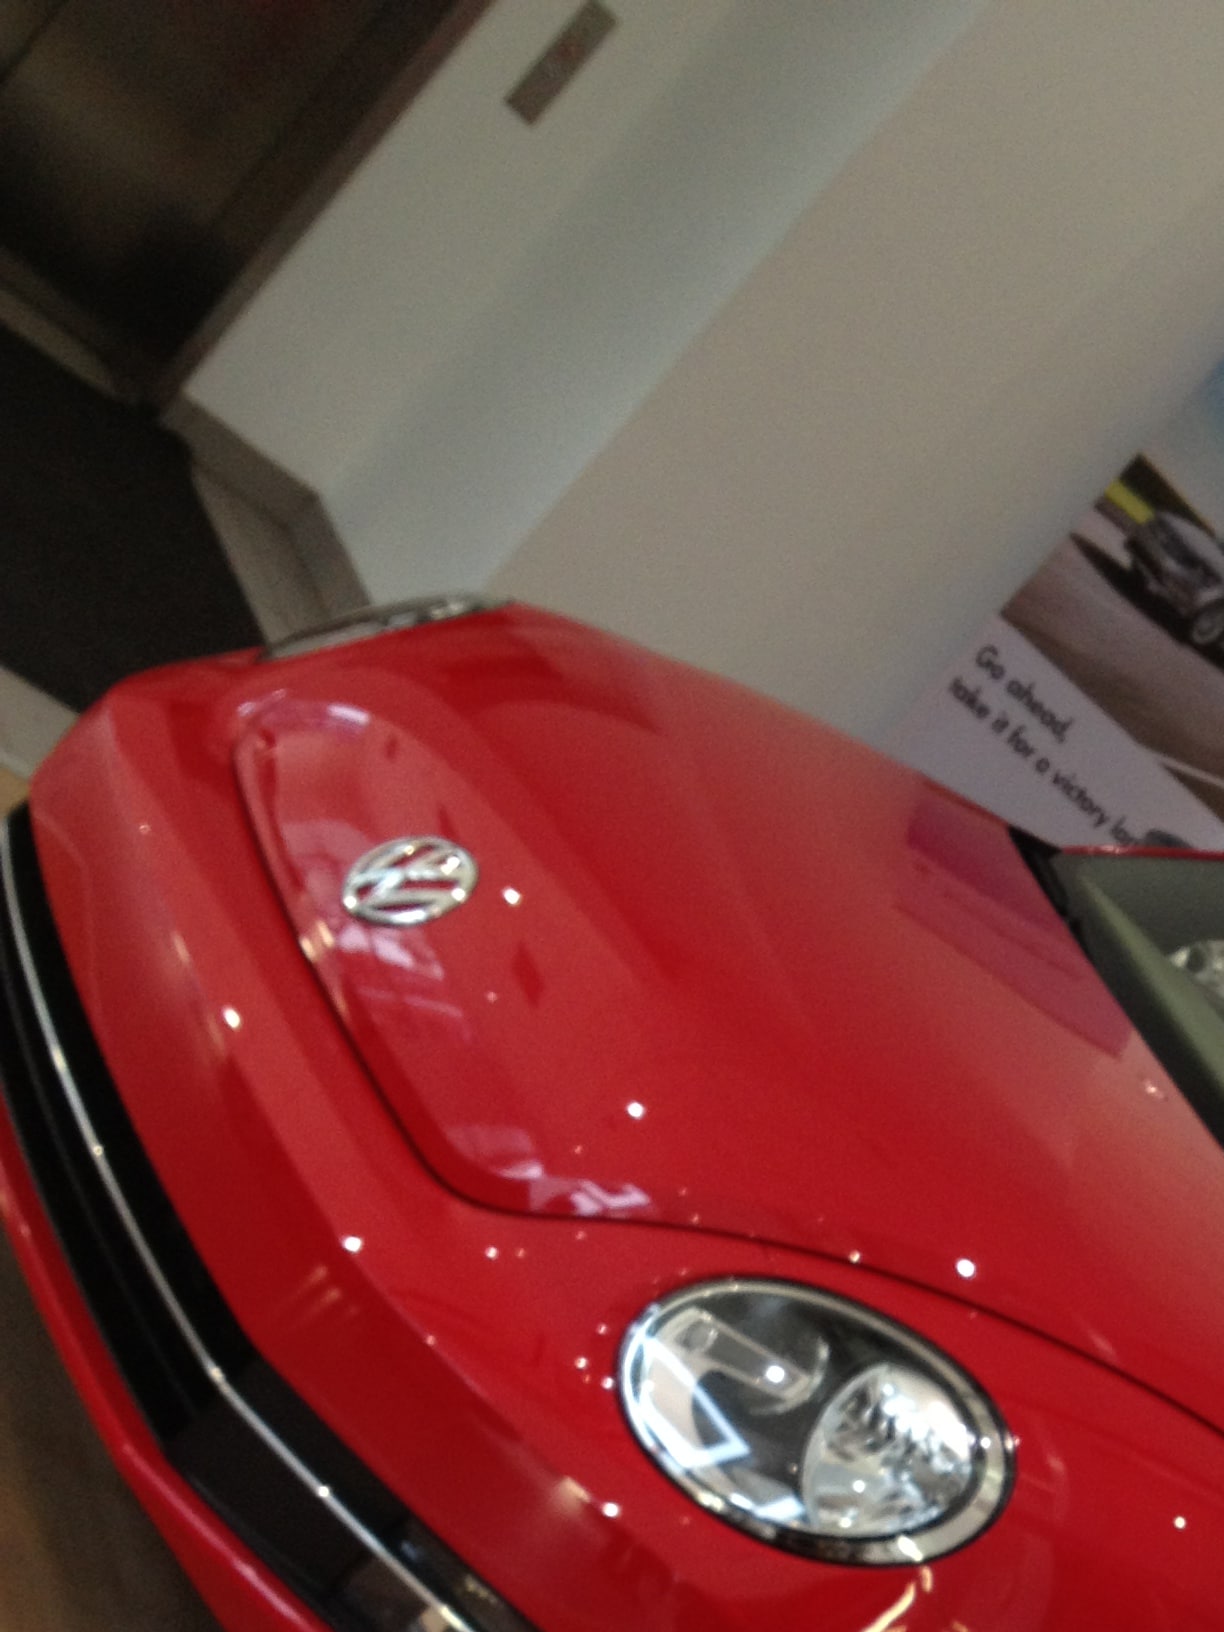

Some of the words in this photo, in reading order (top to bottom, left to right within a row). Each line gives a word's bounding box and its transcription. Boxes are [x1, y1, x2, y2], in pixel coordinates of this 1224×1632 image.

[948, 676, 992, 720] take
[990, 715, 1014, 734] it
[1006, 726, 1042, 759] for
[1050, 768, 1111, 830] victory
[974, 644, 1008, 682] Go
[1004, 674, 1075, 745] ahead,
